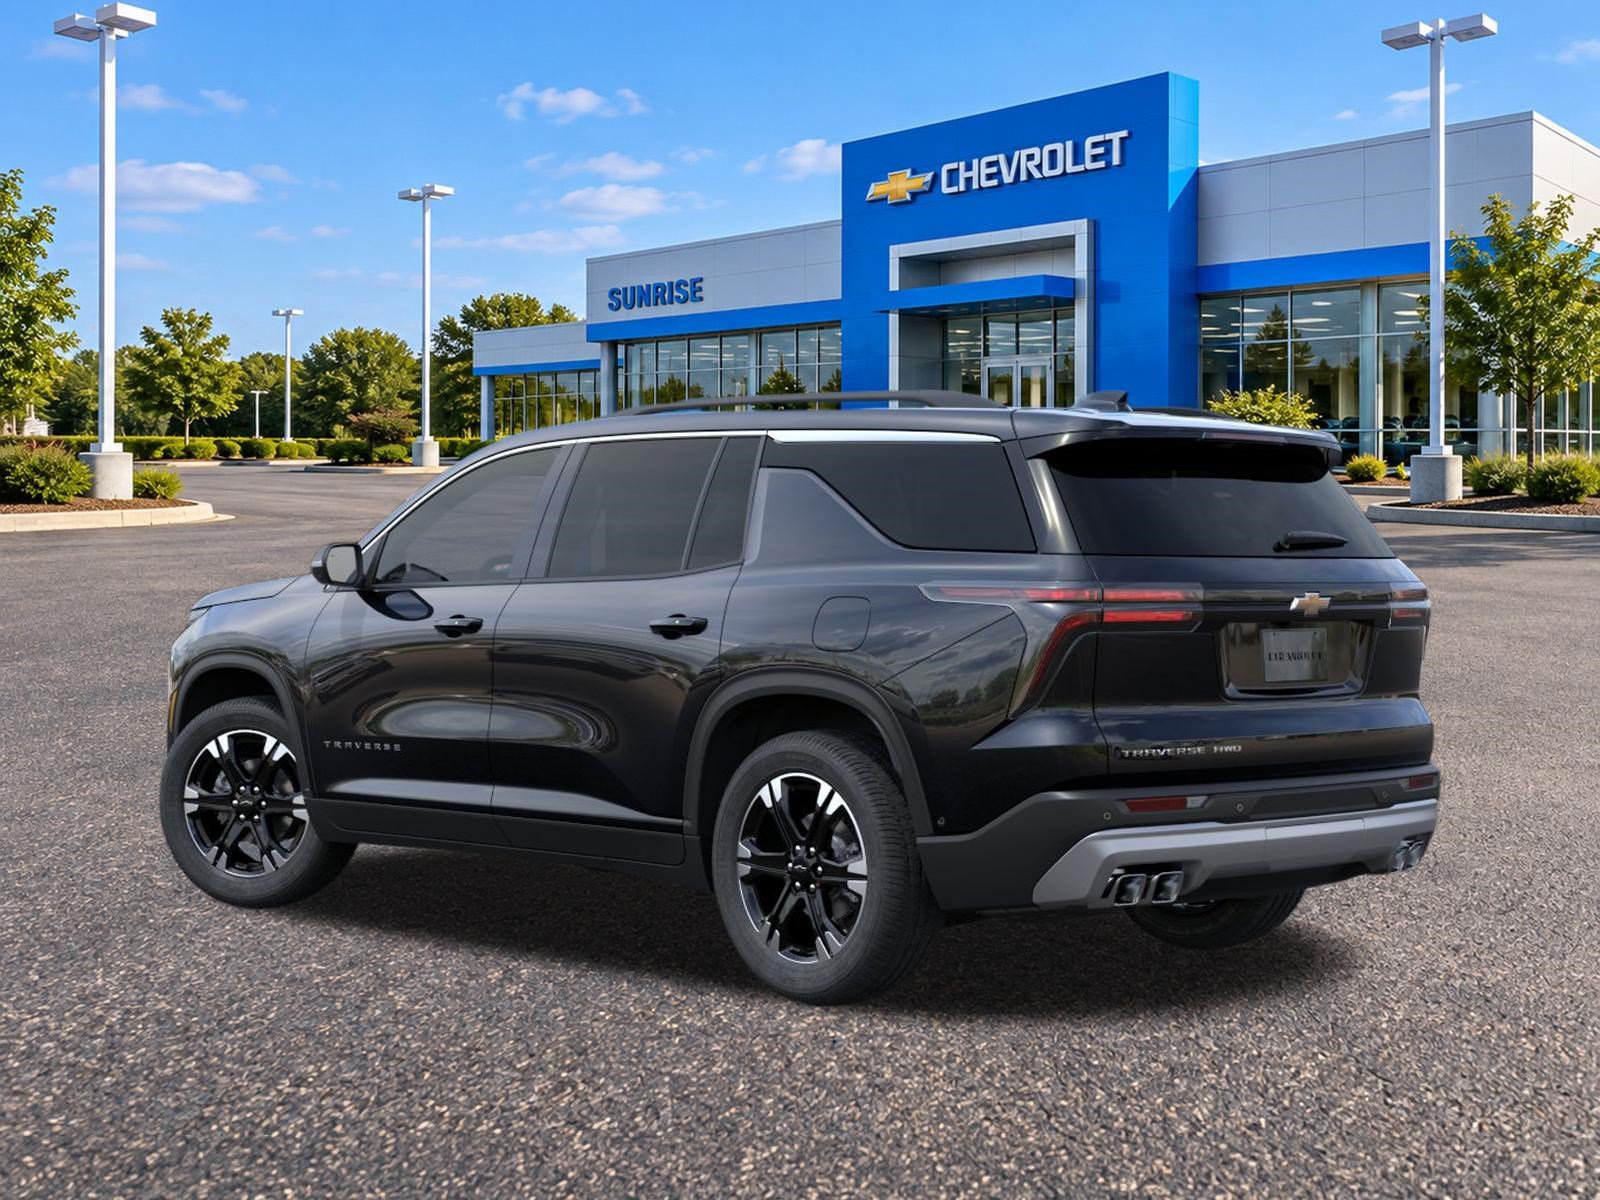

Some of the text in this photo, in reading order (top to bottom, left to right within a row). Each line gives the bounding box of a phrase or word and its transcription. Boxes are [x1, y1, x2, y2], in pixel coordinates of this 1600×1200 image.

[941, 130, 1129, 194] CHEVROLET
[607, 277, 704, 312] SUNRISE
[322, 740, 401, 752] TRAVERSE
[1120, 746, 1206, 758] TRAVERSE
